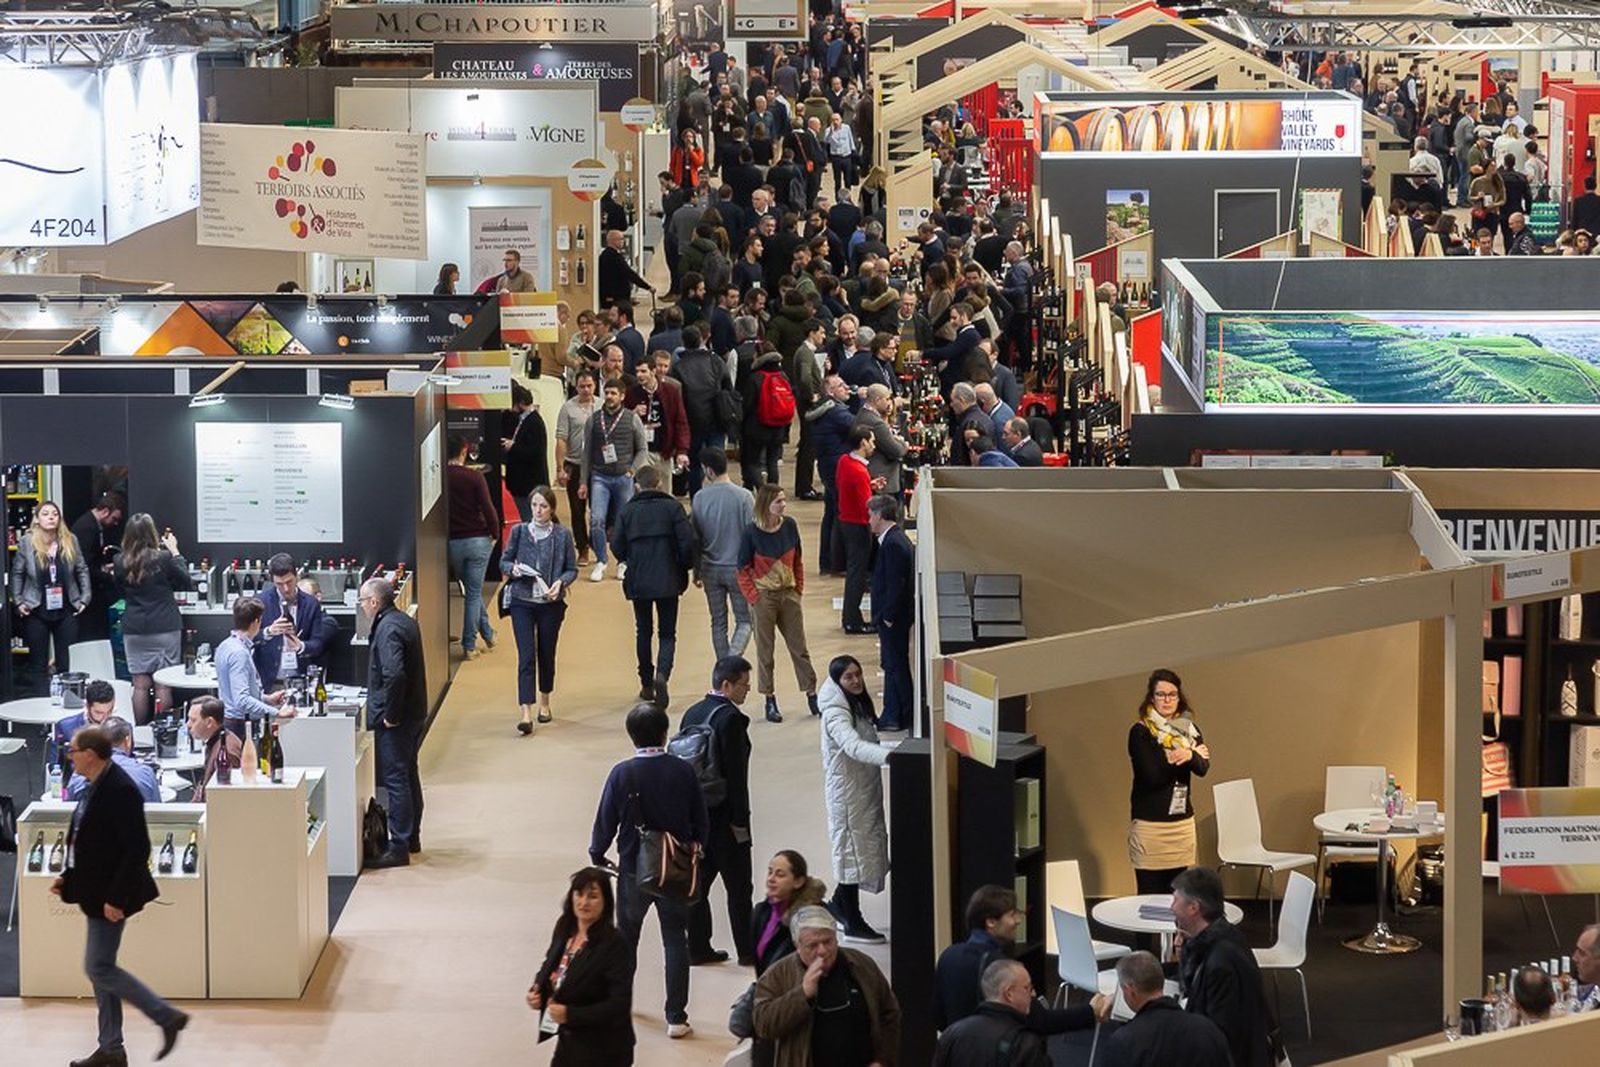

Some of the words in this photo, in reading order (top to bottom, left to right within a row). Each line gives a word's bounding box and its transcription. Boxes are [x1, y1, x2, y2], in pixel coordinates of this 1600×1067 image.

[415, 12, 610, 34] CHAPOUTIER
[778, 19, 787, 28] E
[452, 60, 515, 71] CHATEAU
[532, 63, 543, 77] &
[440, 71, 458, 80] LES
[460, 71, 528, 80] AMOUREUSES
[530, 125, 586, 143] VIGNE
[1281, 124, 1318, 137] VALLEY
[1281, 138, 1336, 151] VINEYARDS
[255, 181, 312, 198] TERROIRS
[313, 183, 366, 201] ASSOCIÉS
[326, 209, 357, 220] Histoires
[30, 218, 97, 238] 4F204
[326, 220, 365, 231] d'Hommes
[326, 229, 336, 238] de
[337, 230, 352, 238] Vins
[306, 315, 318, 323] La
[318, 315, 354, 325] passion,
[356, 315, 375, 323] tout
[1503, 826, 1561, 835] FEDERATION
[1560, 834, 1591, 843] TERRA
[1504, 851, 1510, 859] 4
[1511, 851, 1518, 859] E
[1519, 851, 1536, 859] 222
